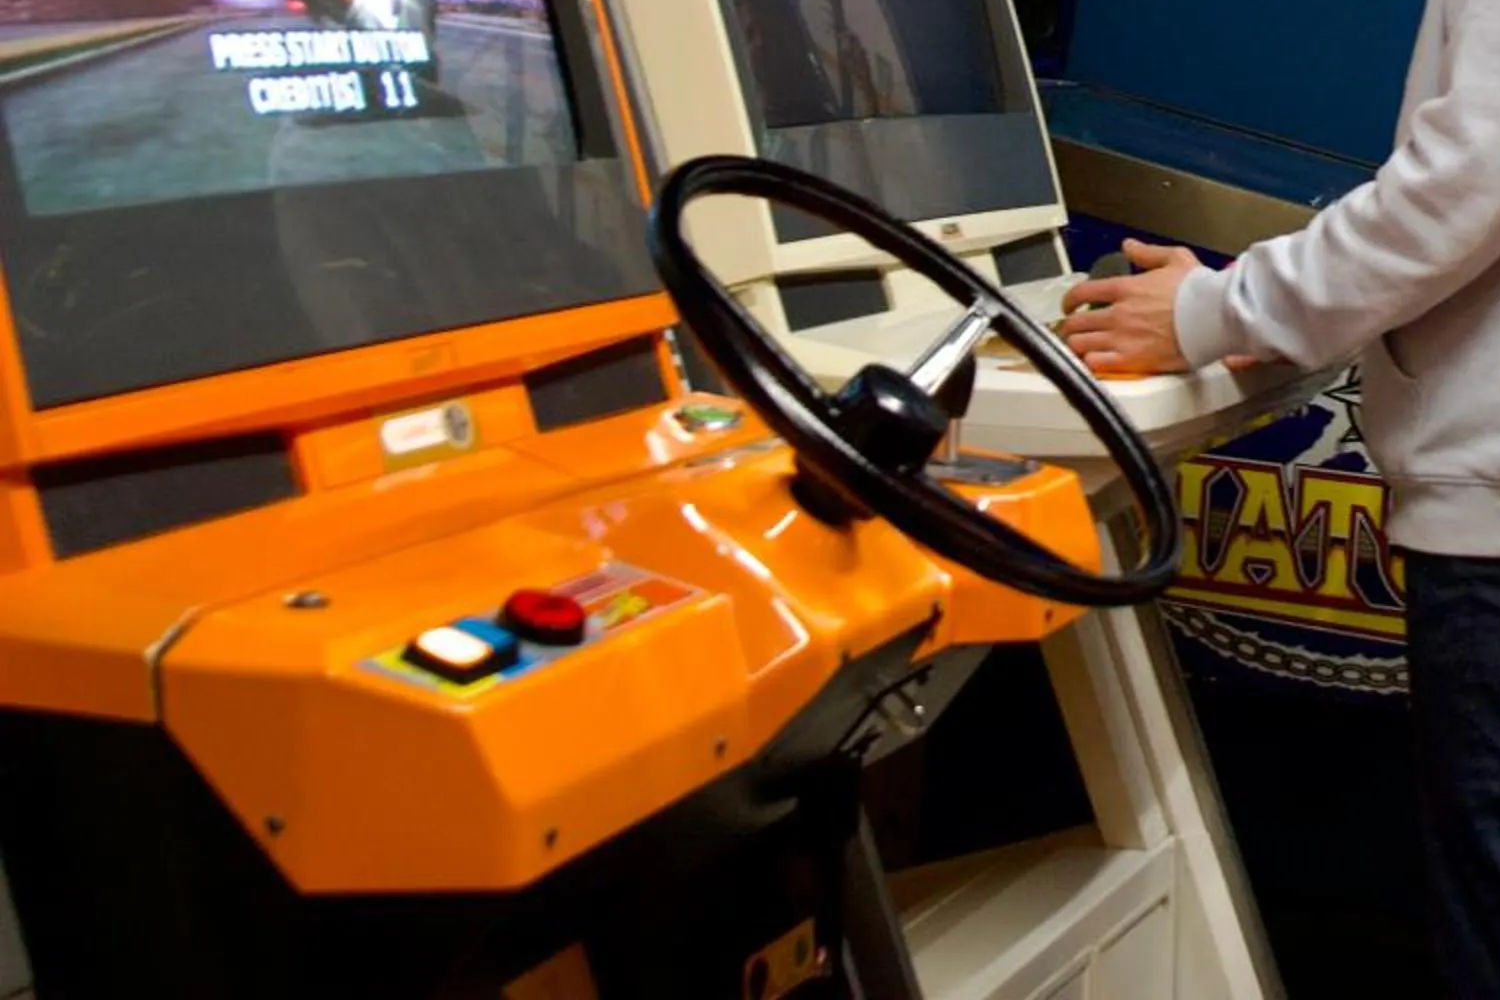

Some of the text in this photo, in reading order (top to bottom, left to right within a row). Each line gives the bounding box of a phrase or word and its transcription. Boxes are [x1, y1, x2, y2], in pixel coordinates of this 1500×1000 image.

[209, 30, 430, 69] PRESS START BUTTON
[380, 70, 418, 108] 11
